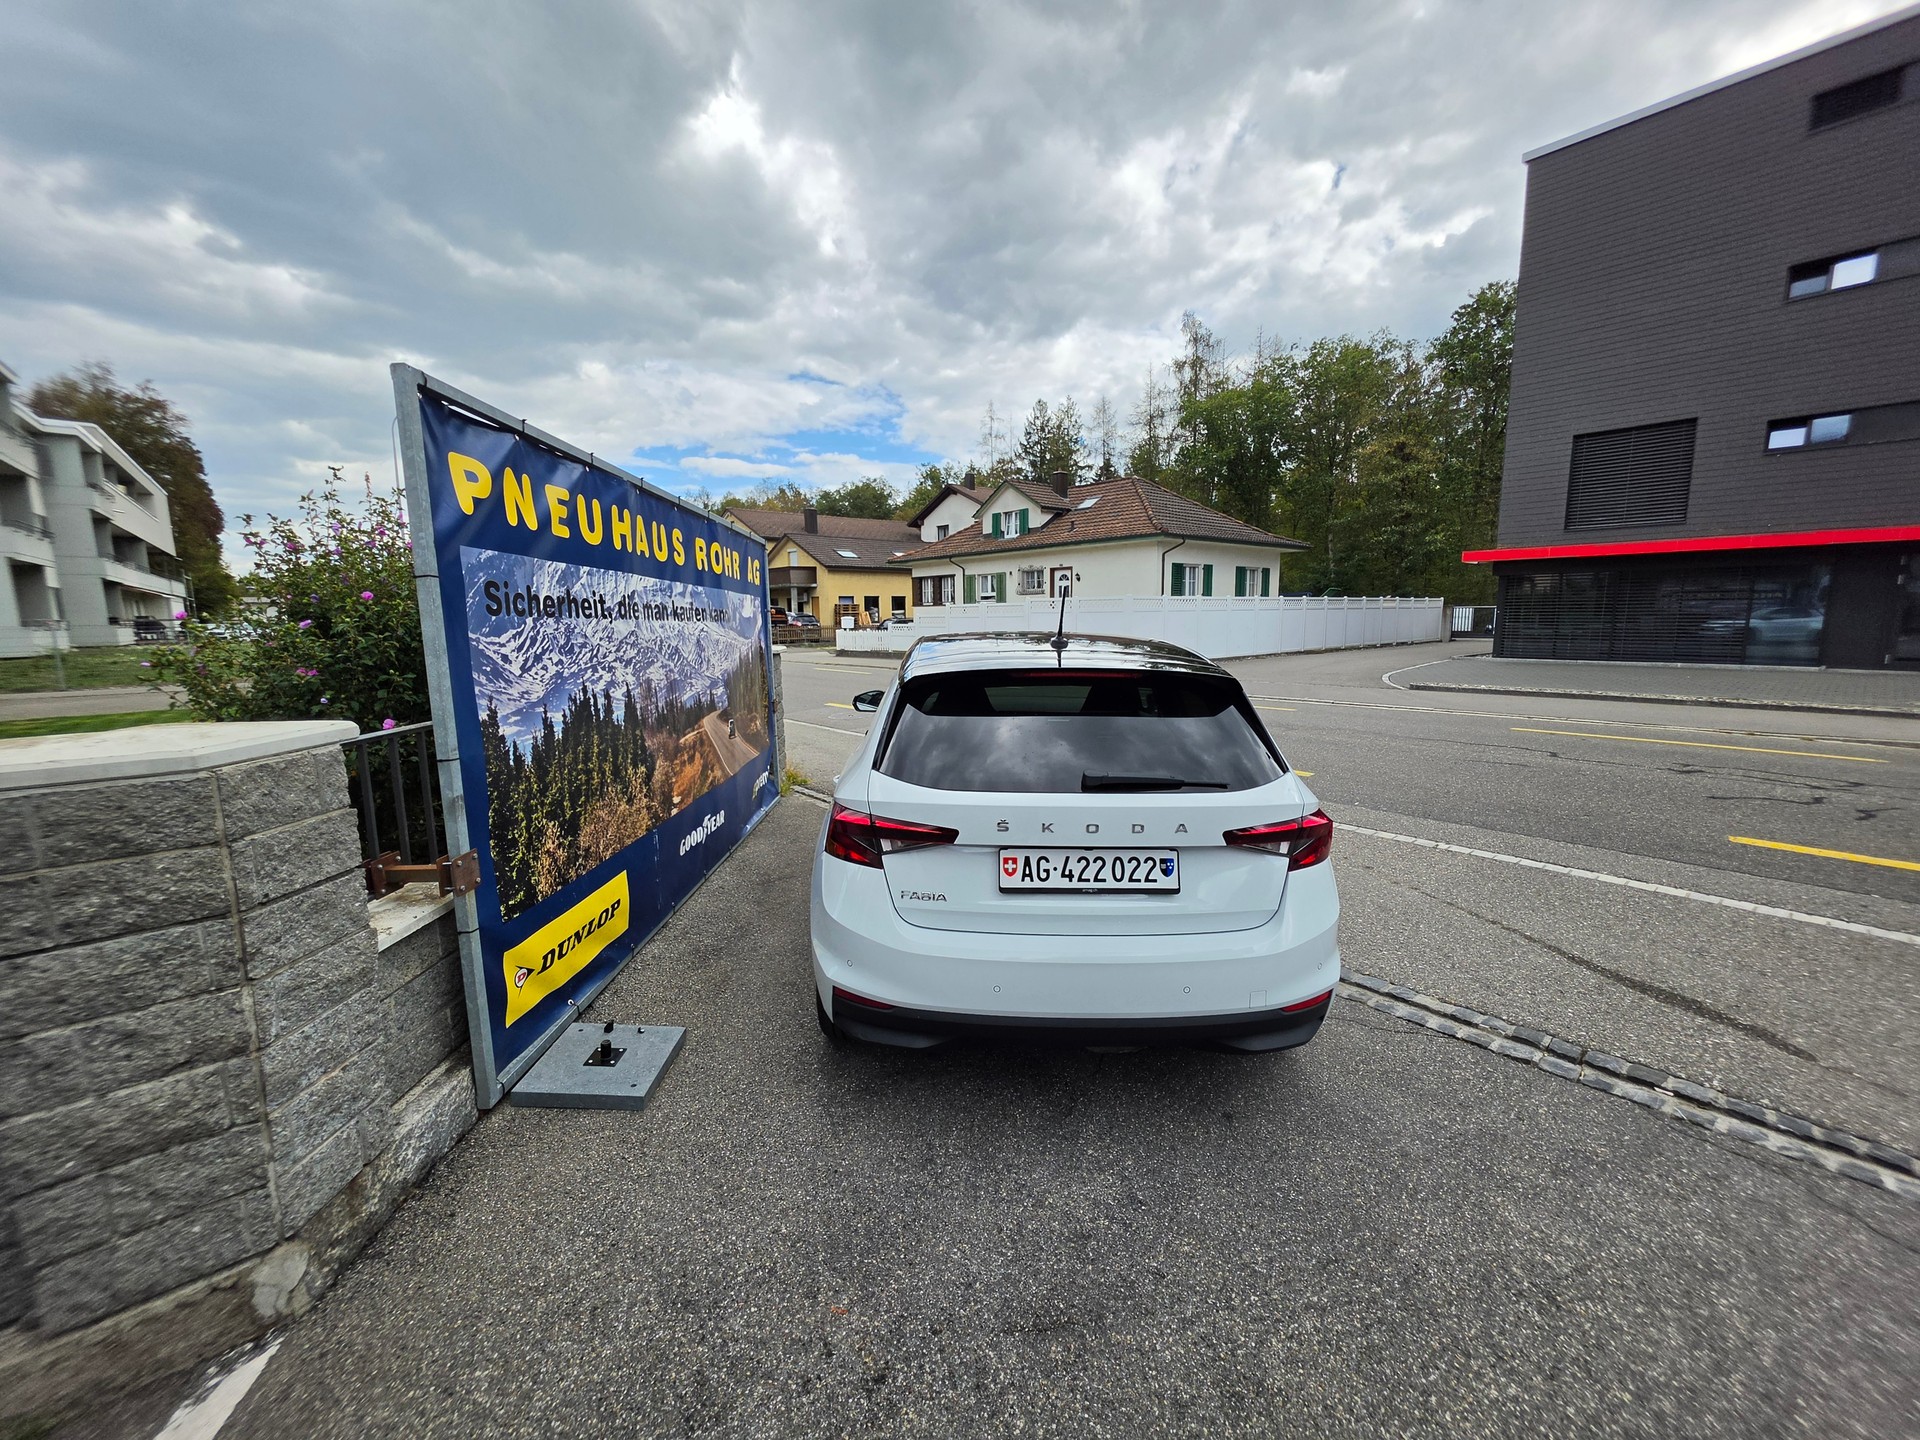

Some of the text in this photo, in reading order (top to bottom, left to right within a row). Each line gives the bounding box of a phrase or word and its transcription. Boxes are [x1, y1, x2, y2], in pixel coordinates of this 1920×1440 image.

[447, 451, 761, 586] PNEUHAUS ROHR AG
[483, 580, 613, 623] Sicherheit,
[619, 594, 640, 620] die
[642, 602, 669, 621] man
[671, 600, 707, 622] kaufen
[680, 810, 725, 856] GOODYEAR
[996, 819, 1188, 834] ŠKODA
[900, 890, 948, 902] FABIA
[537, 898, 621, 976] DUNLOP
